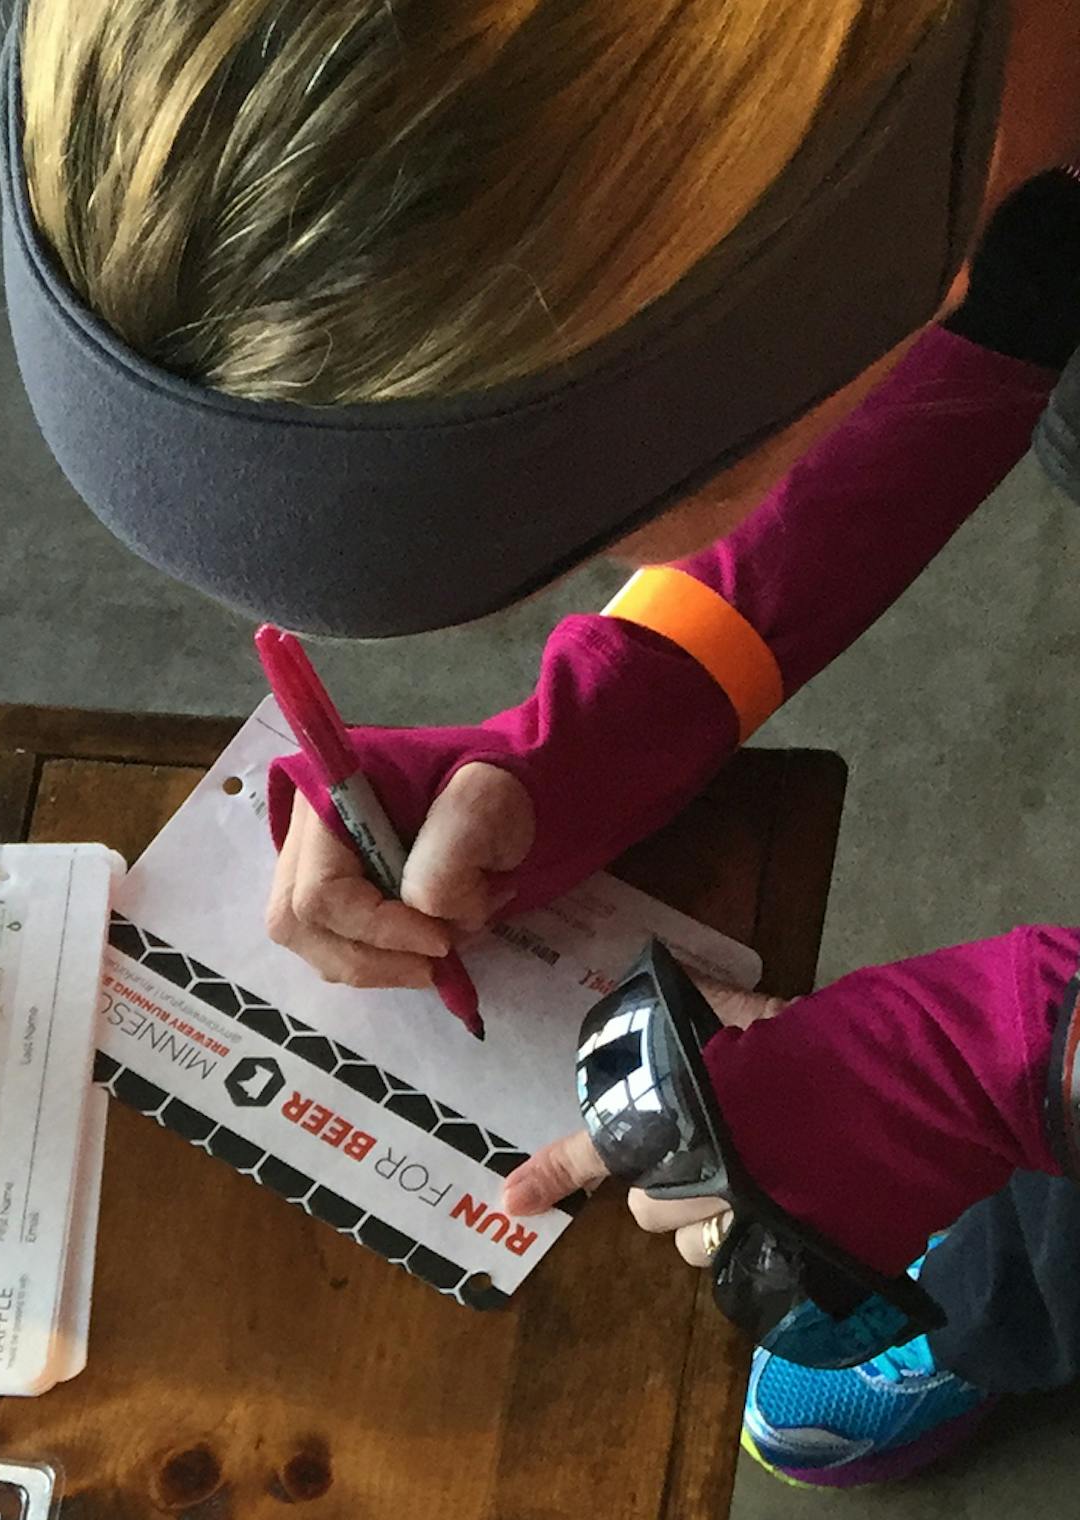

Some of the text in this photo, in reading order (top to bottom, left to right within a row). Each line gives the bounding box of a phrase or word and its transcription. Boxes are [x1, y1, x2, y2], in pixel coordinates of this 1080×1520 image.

[170, 1012, 231, 1058] BREWERY
[281, 1091, 538, 1257] RUN FOR BEER
